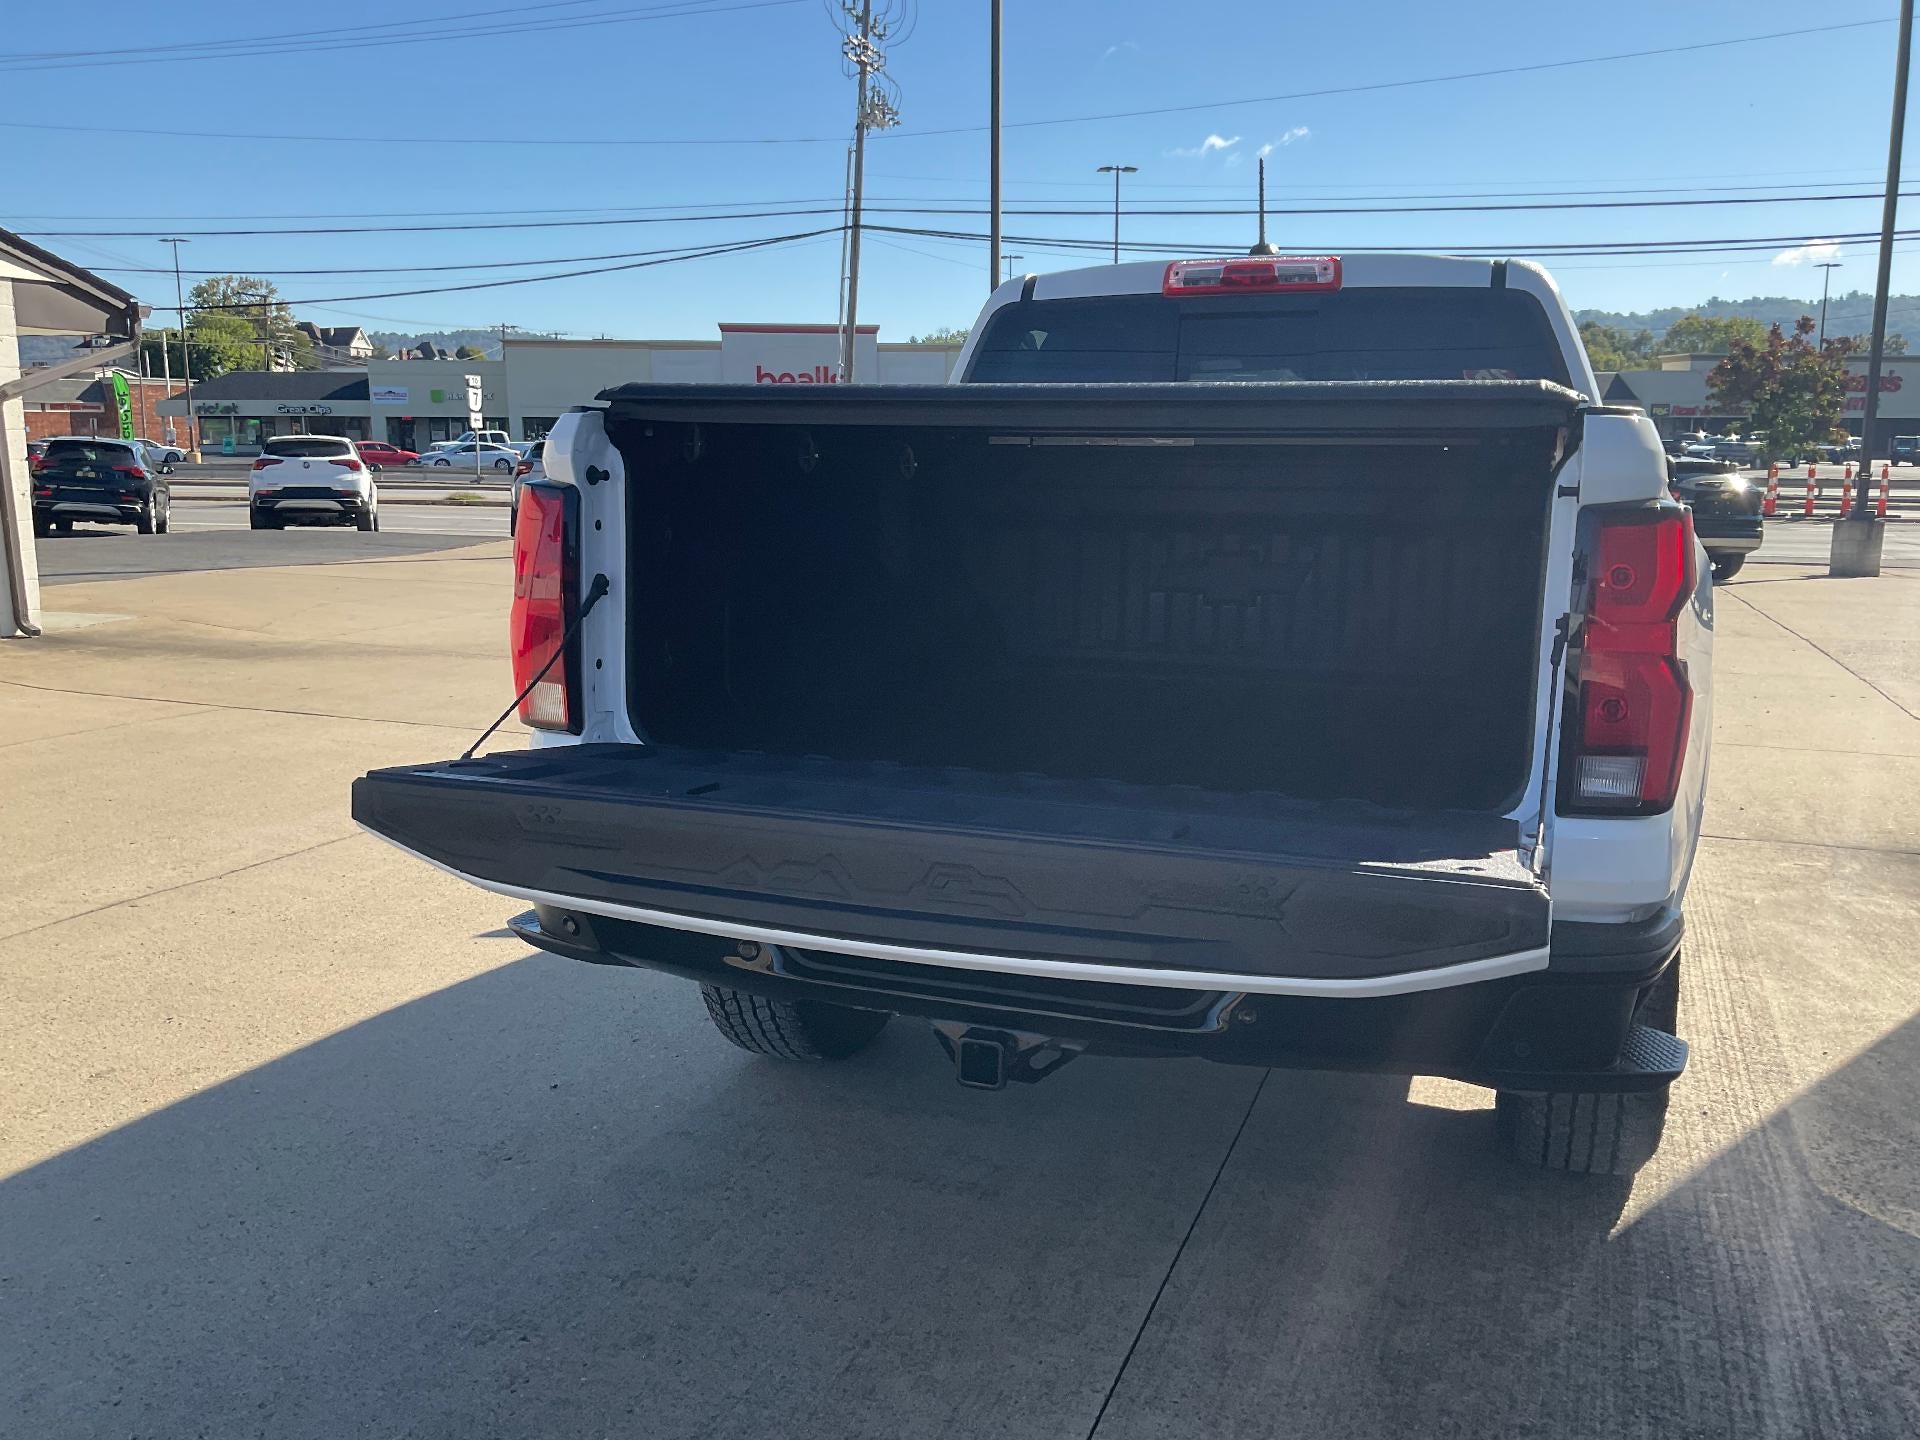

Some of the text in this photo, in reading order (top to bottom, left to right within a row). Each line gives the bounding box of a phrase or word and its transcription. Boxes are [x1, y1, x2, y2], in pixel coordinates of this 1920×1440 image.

[757, 365, 844, 384] beall
[472, 391, 479, 406] 7
[277, 403, 332, 416] Great Clips
